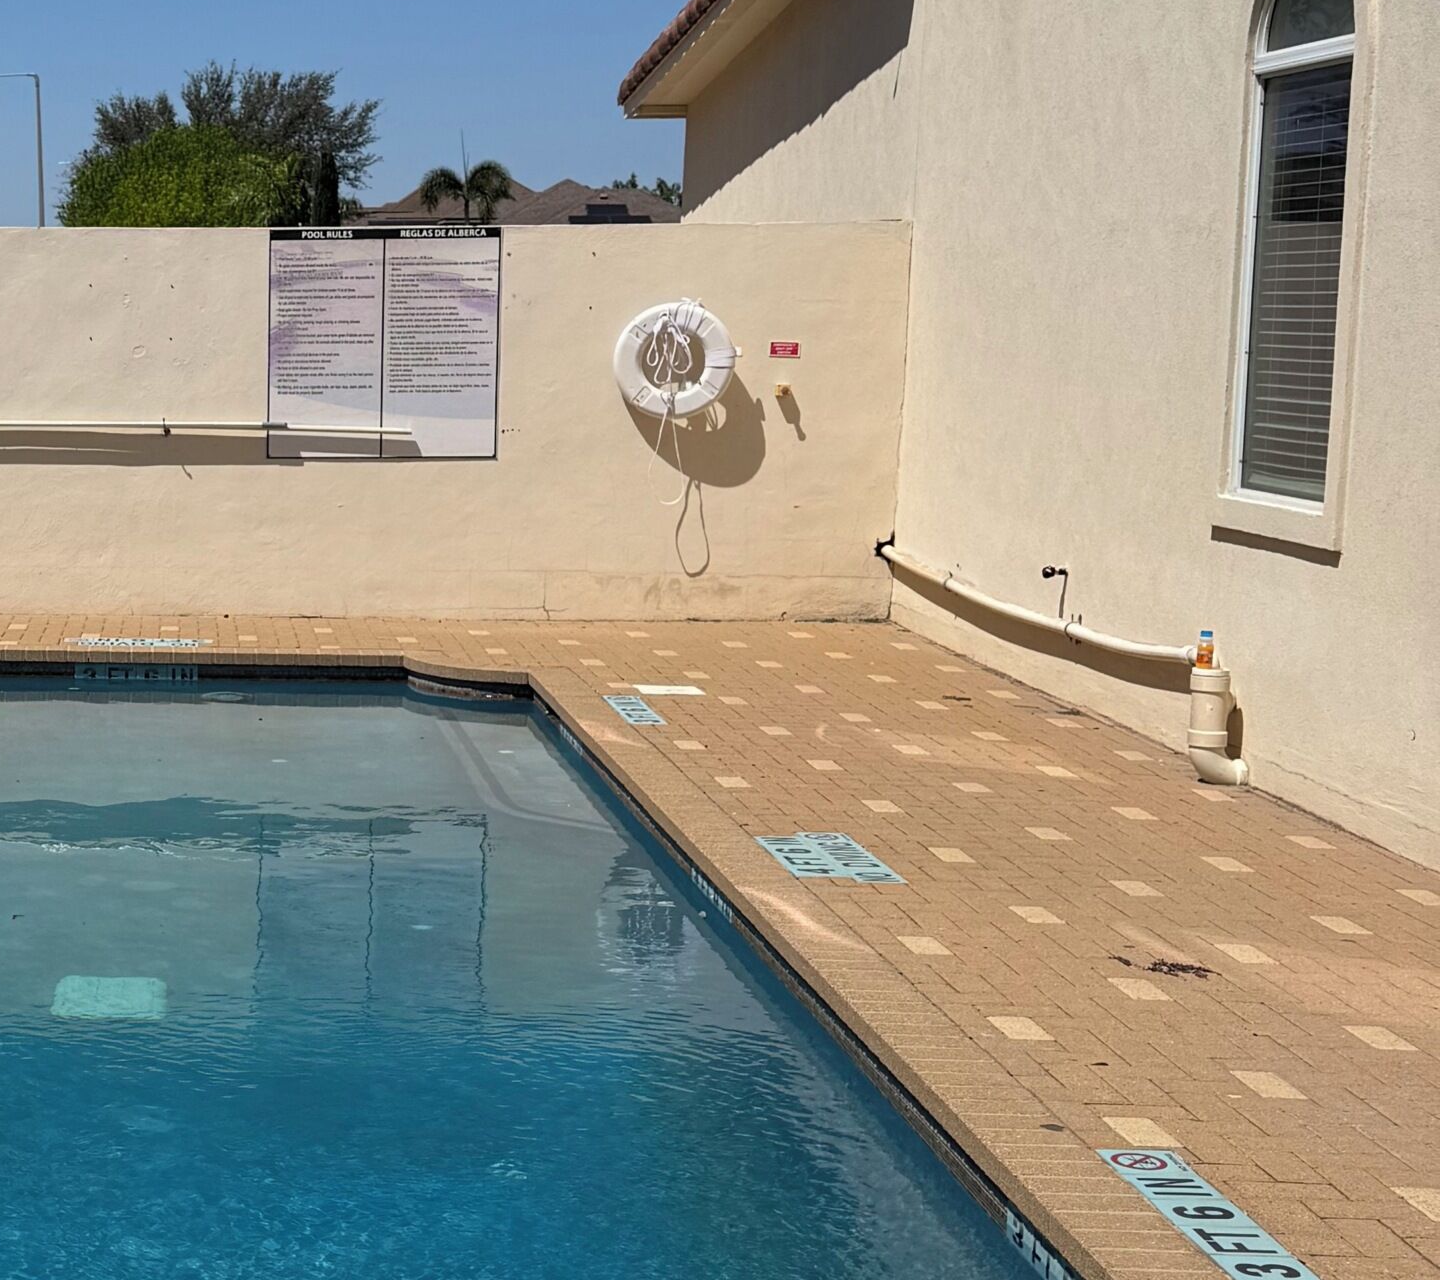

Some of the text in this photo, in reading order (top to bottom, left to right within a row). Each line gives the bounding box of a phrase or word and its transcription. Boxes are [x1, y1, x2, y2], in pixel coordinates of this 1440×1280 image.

[301, 230, 353, 239] POOL RULES
[400, 228, 487, 237] REGLAS DE ALBERCA
[783, 855, 830, 866] FT
[817, 842, 901, 883] NO DIVING
[796, 867, 836, 875] 4
[1136, 1176, 1302, 1279] 3 FT 6 IN
